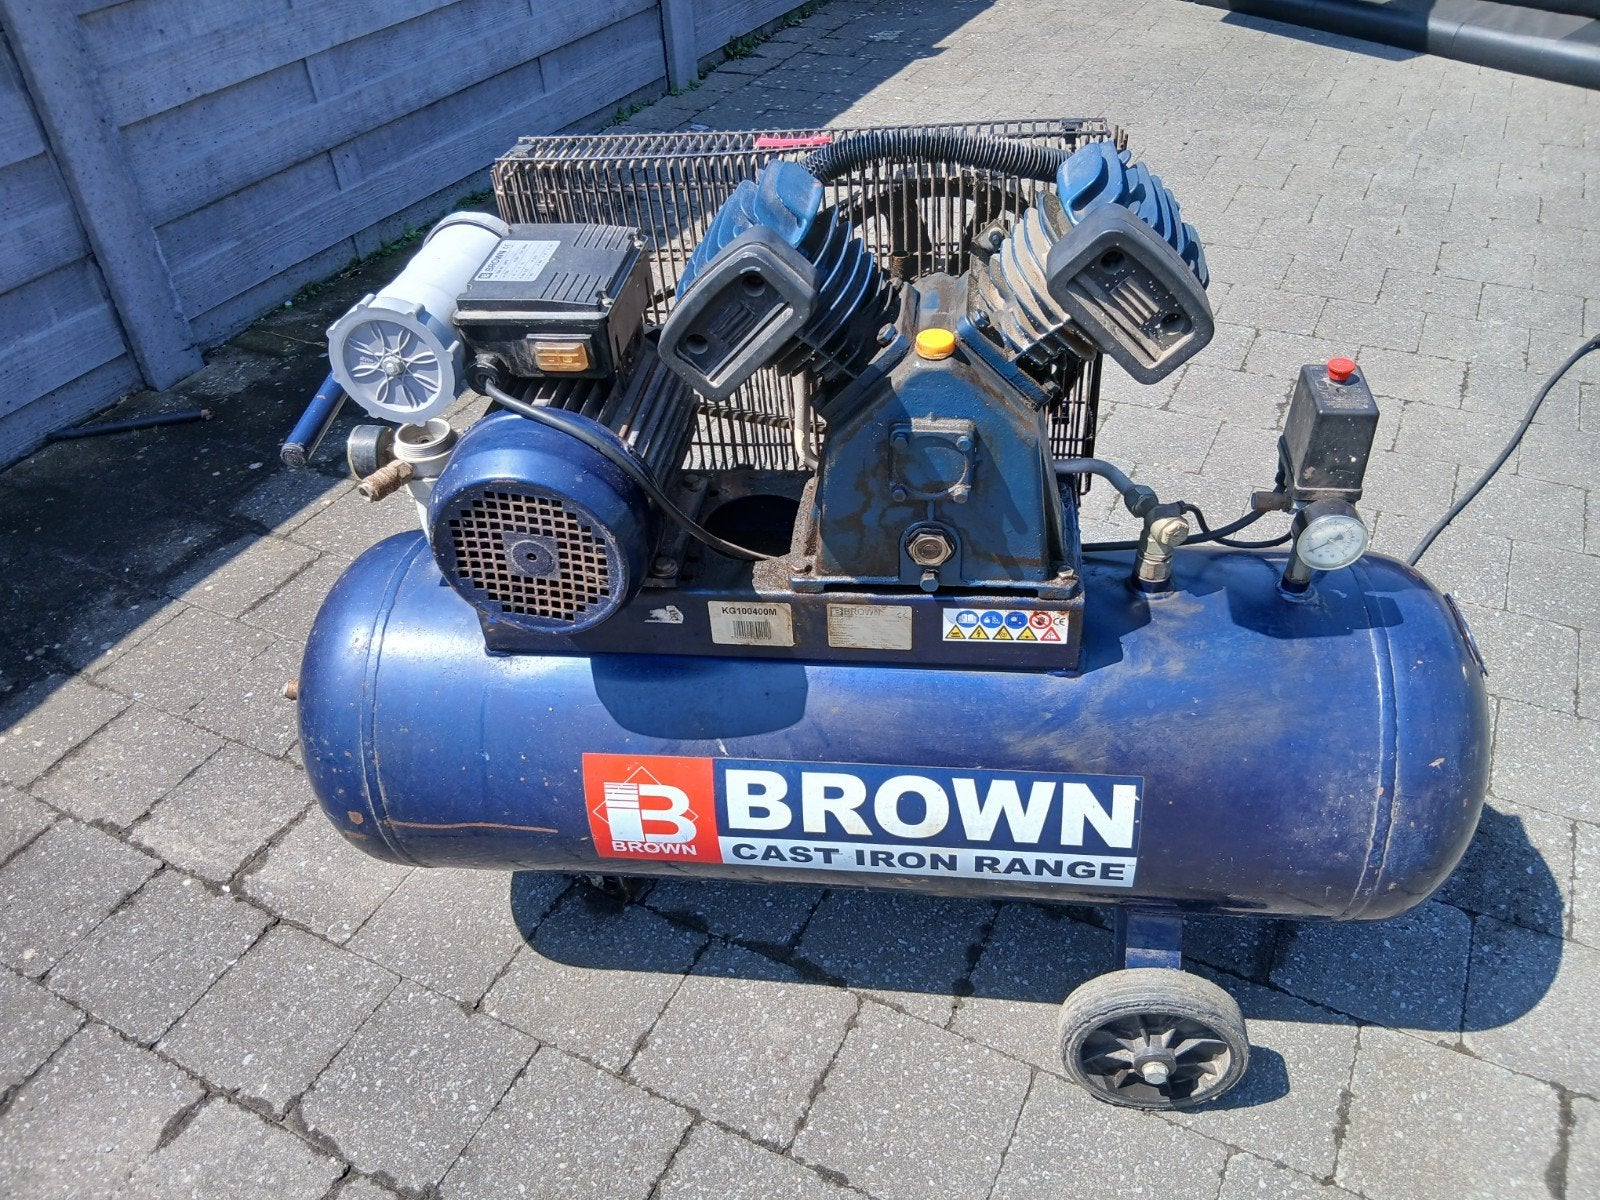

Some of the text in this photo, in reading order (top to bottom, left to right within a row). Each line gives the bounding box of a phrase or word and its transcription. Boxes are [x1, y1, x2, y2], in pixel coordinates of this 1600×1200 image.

[485, 249, 507, 272] BROWN
[722, 606, 777, 616] KG100400M
[843, 607, 882, 616] BROWN
[1053, 617, 1066, 626] CE
[724, 768, 1138, 849] BROWN
[611, 840, 698, 856] BROWN
[731, 843, 1126, 881] CAST IRON RANGE
